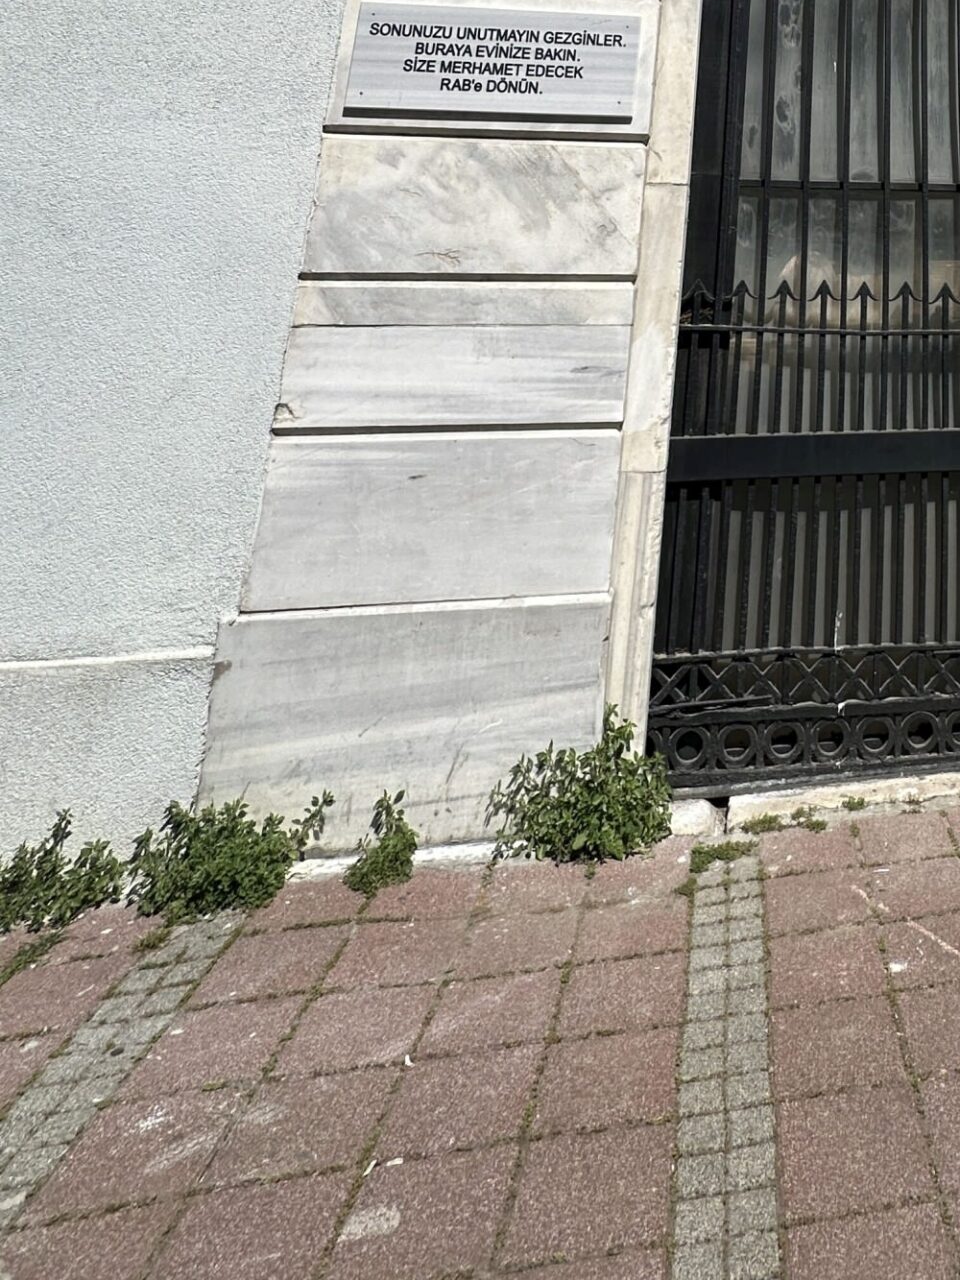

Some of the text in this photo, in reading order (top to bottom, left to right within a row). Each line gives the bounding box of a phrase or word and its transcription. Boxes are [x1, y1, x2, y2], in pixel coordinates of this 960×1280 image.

[369, 22, 627, 48] SONUNUZU UNUTMAYIN GEZGİNLER.
[415, 42, 581, 62] BURAYA EVİNİZE BAKIN.
[403, 57, 583, 79] SİZE MERHAMET EDECEK
[440, 78, 543, 94] RAB'e DÖNÜN.
